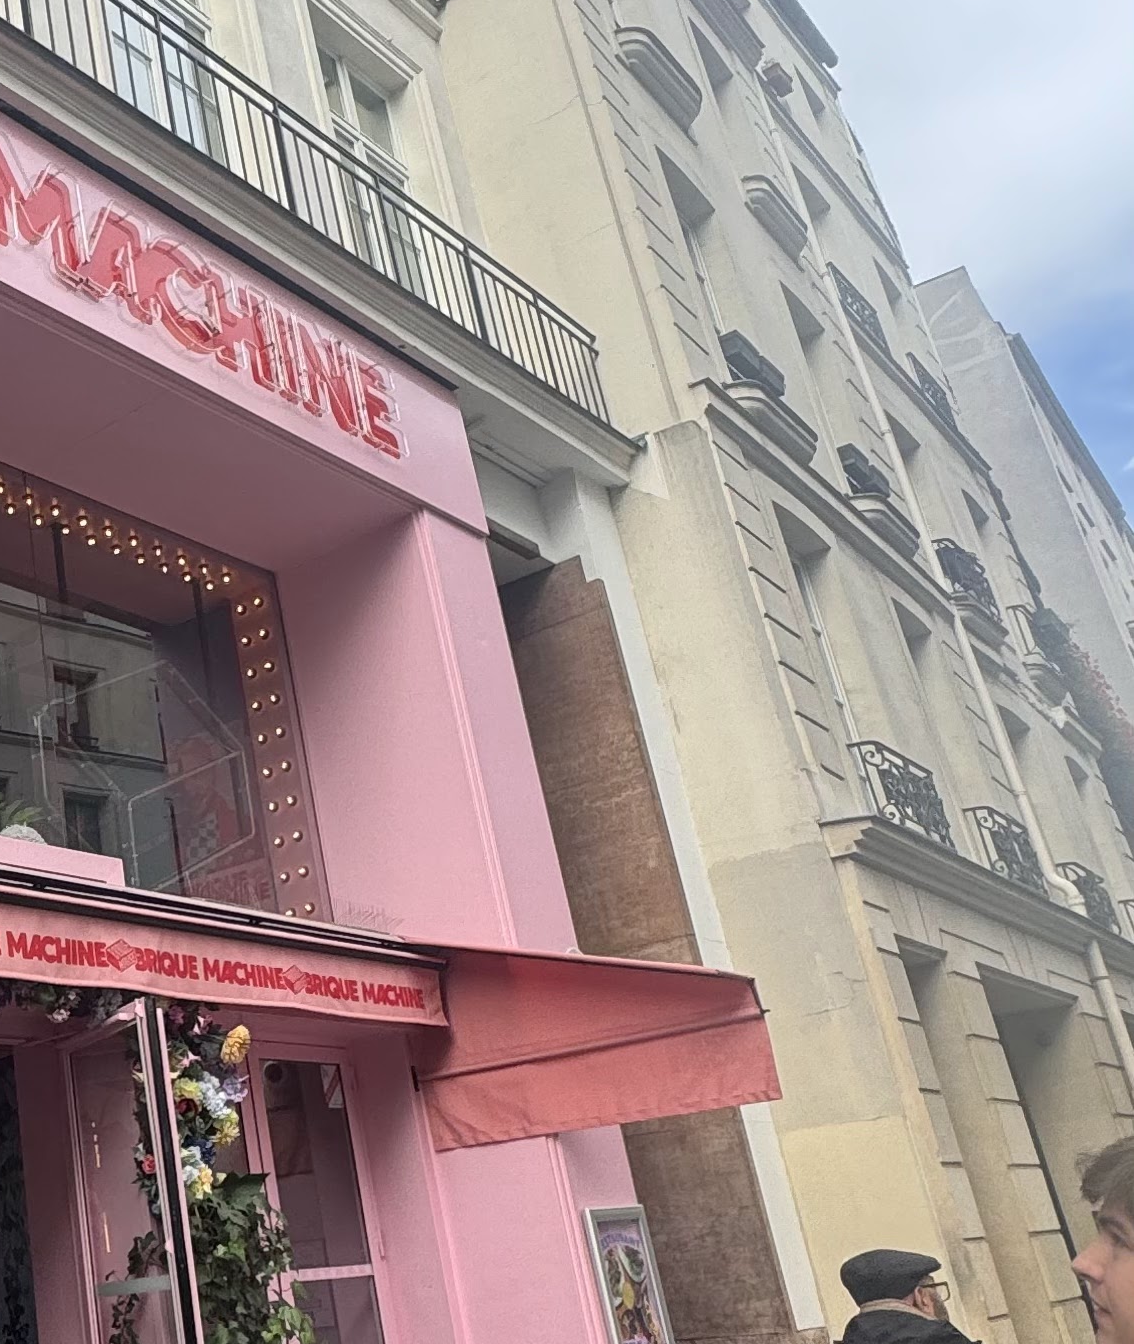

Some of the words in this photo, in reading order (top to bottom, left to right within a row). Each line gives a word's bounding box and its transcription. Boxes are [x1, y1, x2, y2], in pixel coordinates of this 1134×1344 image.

[7, 930, 108, 968] MACHINE
[135, 948, 199, 980] BRIQUE
[203, 958, 285, 990] MACHINE
[304, 976, 358, 1002] BRIQUE
[363, 984, 424, 1009] MACHINE
